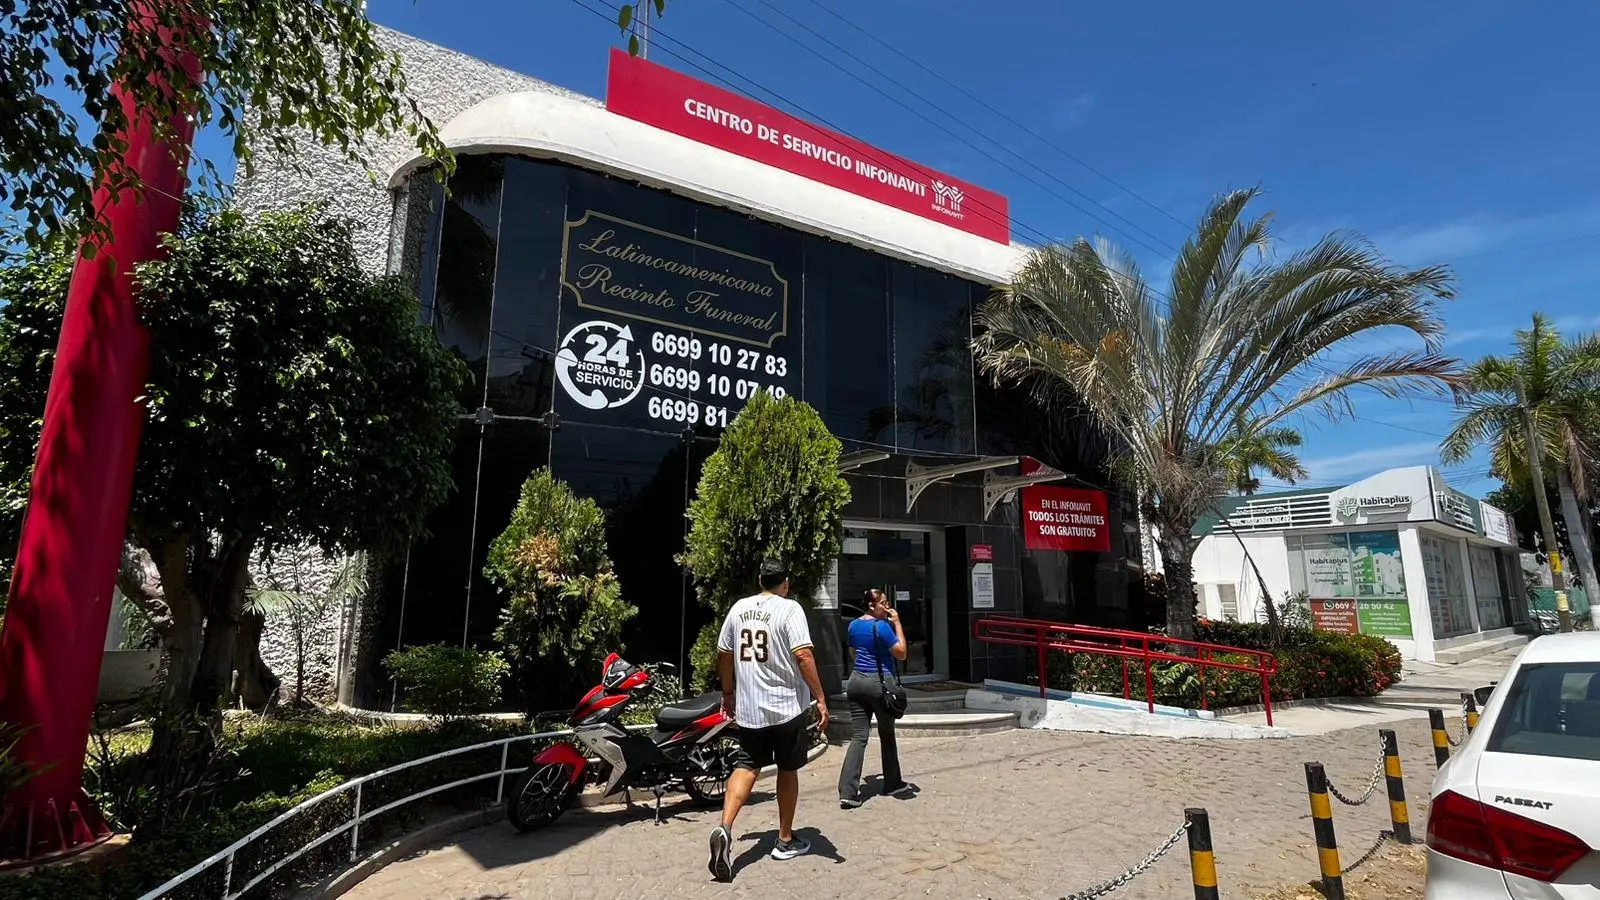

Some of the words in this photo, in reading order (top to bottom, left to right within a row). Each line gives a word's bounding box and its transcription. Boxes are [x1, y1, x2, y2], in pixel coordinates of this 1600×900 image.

[684, 98, 753, 135] CENTRO
[757, 123, 779, 145] DE
[782, 133, 852, 171] SERVICIO
[855, 160, 927, 197] INFONAVIT
[931, 203, 965, 220] INFONAVIT
[578, 229, 775, 298] Latinoamericana
[575, 263, 677, 309] Recinto
[684, 290, 778, 332] Funeral
[583, 333, 630, 368] 24
[651, 331, 702, 360] 6699
[708, 342, 732, 366] 10
[737, 348, 760, 371] 27
[764, 355, 787, 377] 83
[577, 360, 616, 376] HORAS
[619, 368, 633, 379] DE
[575, 371, 634, 391] SERVICIO
[650, 363, 701, 392] 6699
[707, 373, 731, 397] 10
[736, 379, 759, 400] 07
[648, 396, 700, 424] 6699
[704, 405, 727, 428] 81
[1041, 499, 1051, 509] EN
[1051, 500, 1059, 510] EL
[1060, 500, 1092, 512] INFONAVIT
[1360, 495, 1410, 506] Habitaplus
[1028, 510, 1054, 522] TODOS
[1055, 512, 1070, 523] LOS
[1070, 512, 1105, 525] TRÁMITES
[1040, 525, 1056, 536] SON
[1056, 526, 1097, 538] GRATUITOS
[1309, 557, 1348, 566] Habitaplus
[1335, 601, 1350, 610] 669
[740, 628, 769, 662] 23
[1494, 795, 1553, 810] PASSAT
